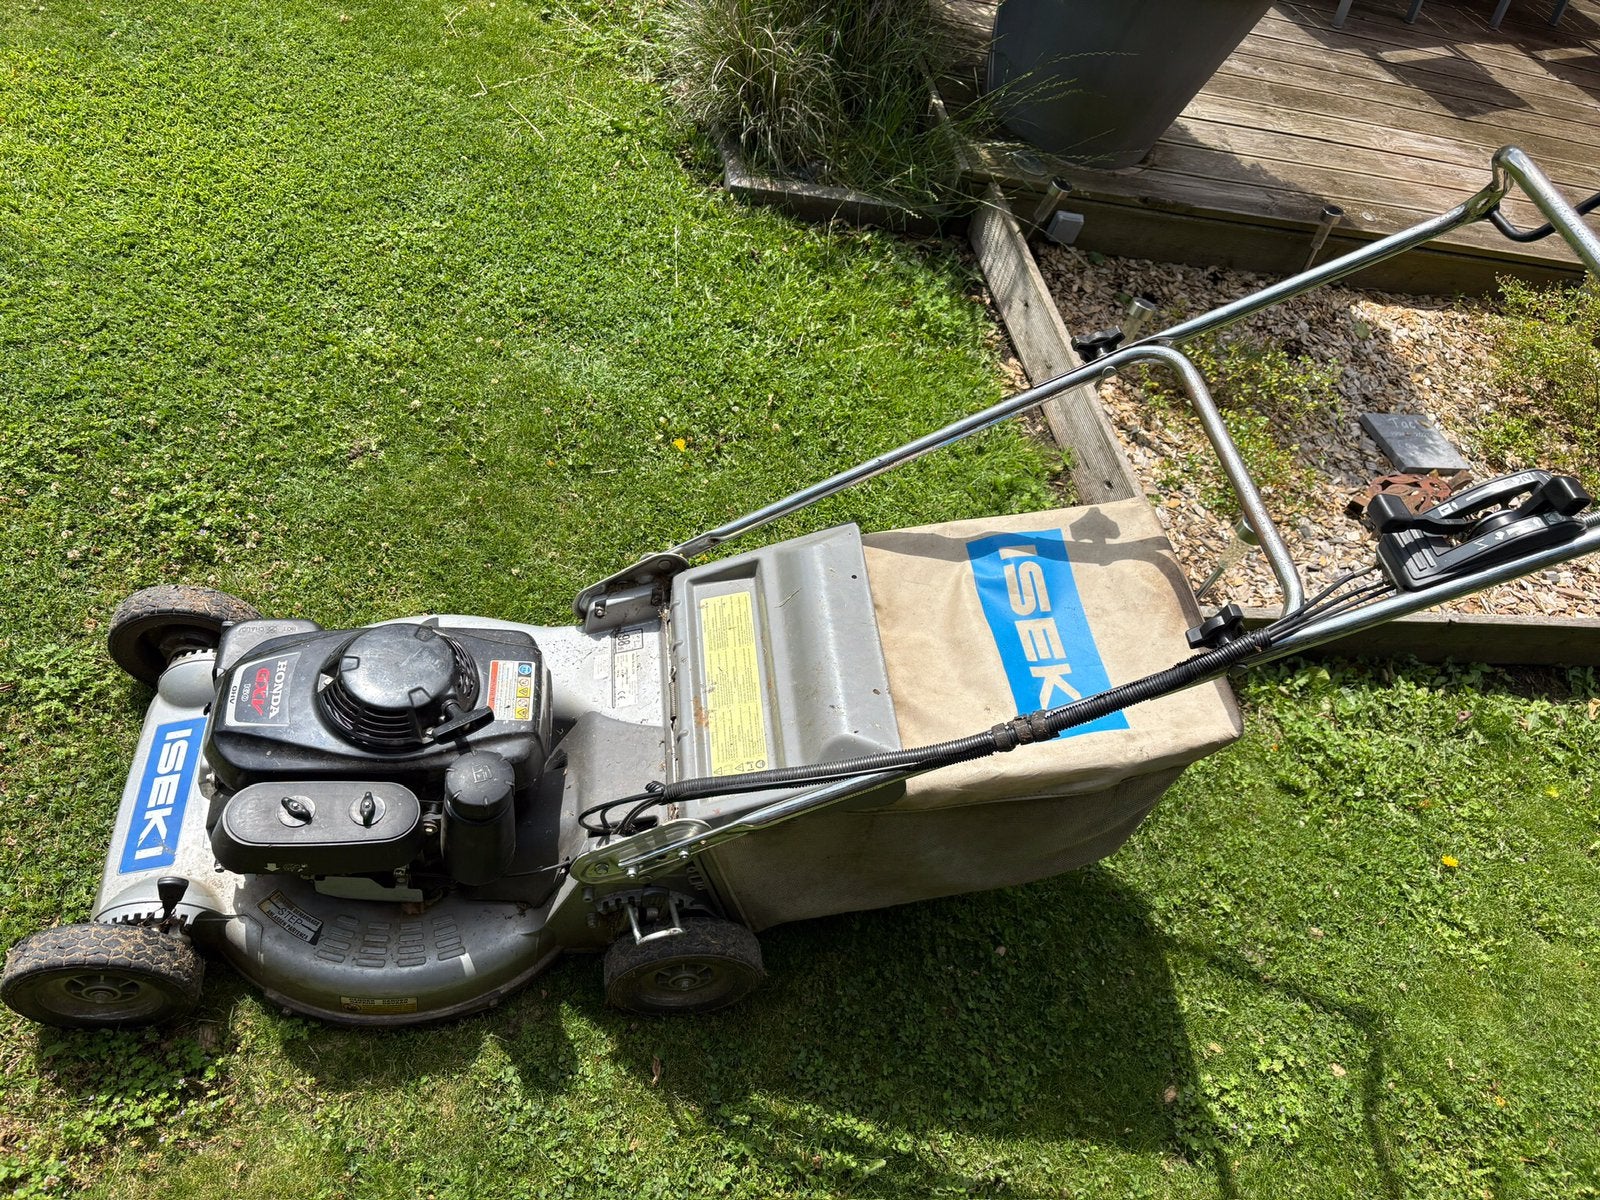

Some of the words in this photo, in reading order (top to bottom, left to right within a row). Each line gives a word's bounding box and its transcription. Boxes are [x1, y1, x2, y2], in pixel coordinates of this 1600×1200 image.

[999, 545, 1082, 711] ISEK
[229, 685, 238, 705] OHV
[251, 668, 271, 717] GXV
[269, 660, 288, 719] HONDA
[134, 729, 193, 861] ISEKI
